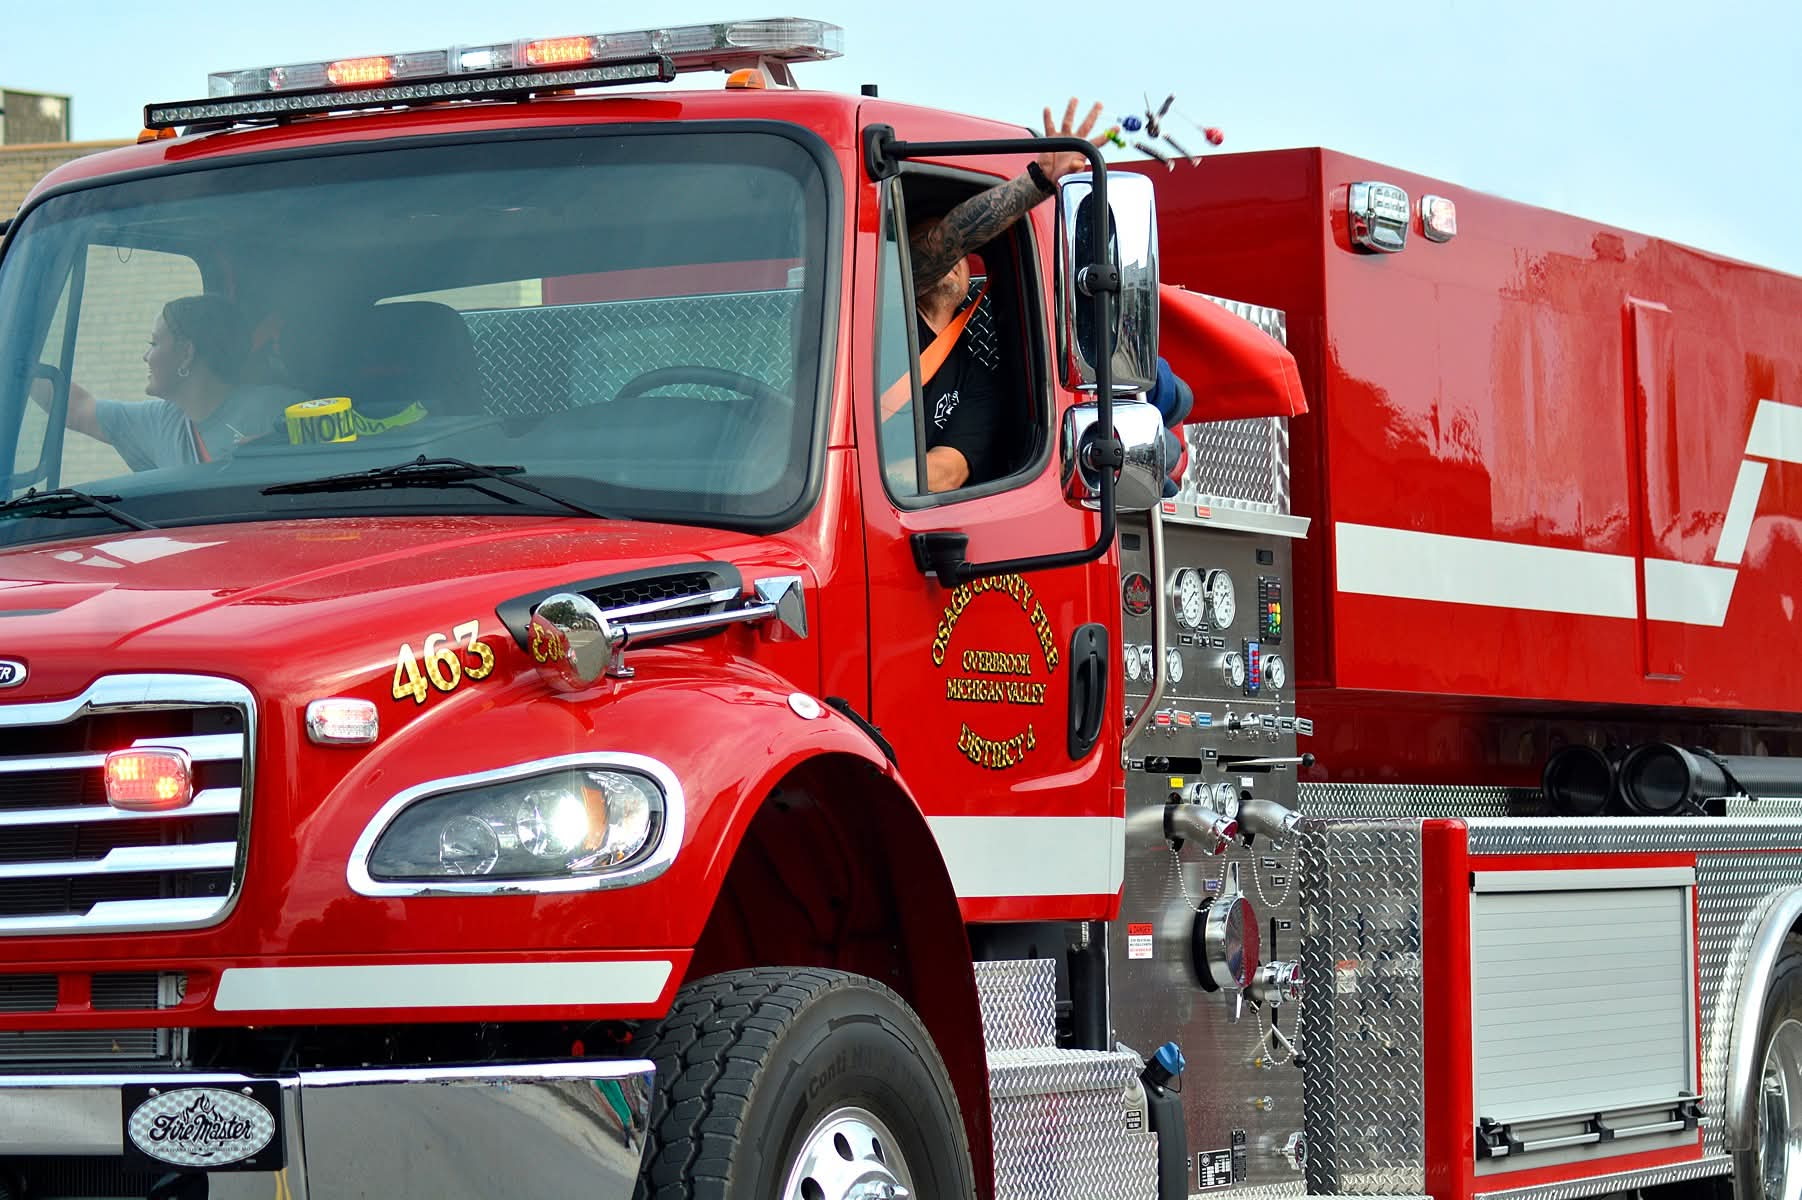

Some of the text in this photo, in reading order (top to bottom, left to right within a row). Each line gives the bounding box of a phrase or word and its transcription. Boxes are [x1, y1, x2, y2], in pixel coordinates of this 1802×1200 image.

[932, 573, 1059, 671] OSAGE COUNTY FIRE
[392, 620, 495, 705] 463
[962, 650, 1032, 675] OVERBROOK
[946, 678, 1047, 704] MICHIGAN VALLEY
[957, 722, 1036, 769] DISTRICT 4
[808, 1049, 847, 1099] Conti
